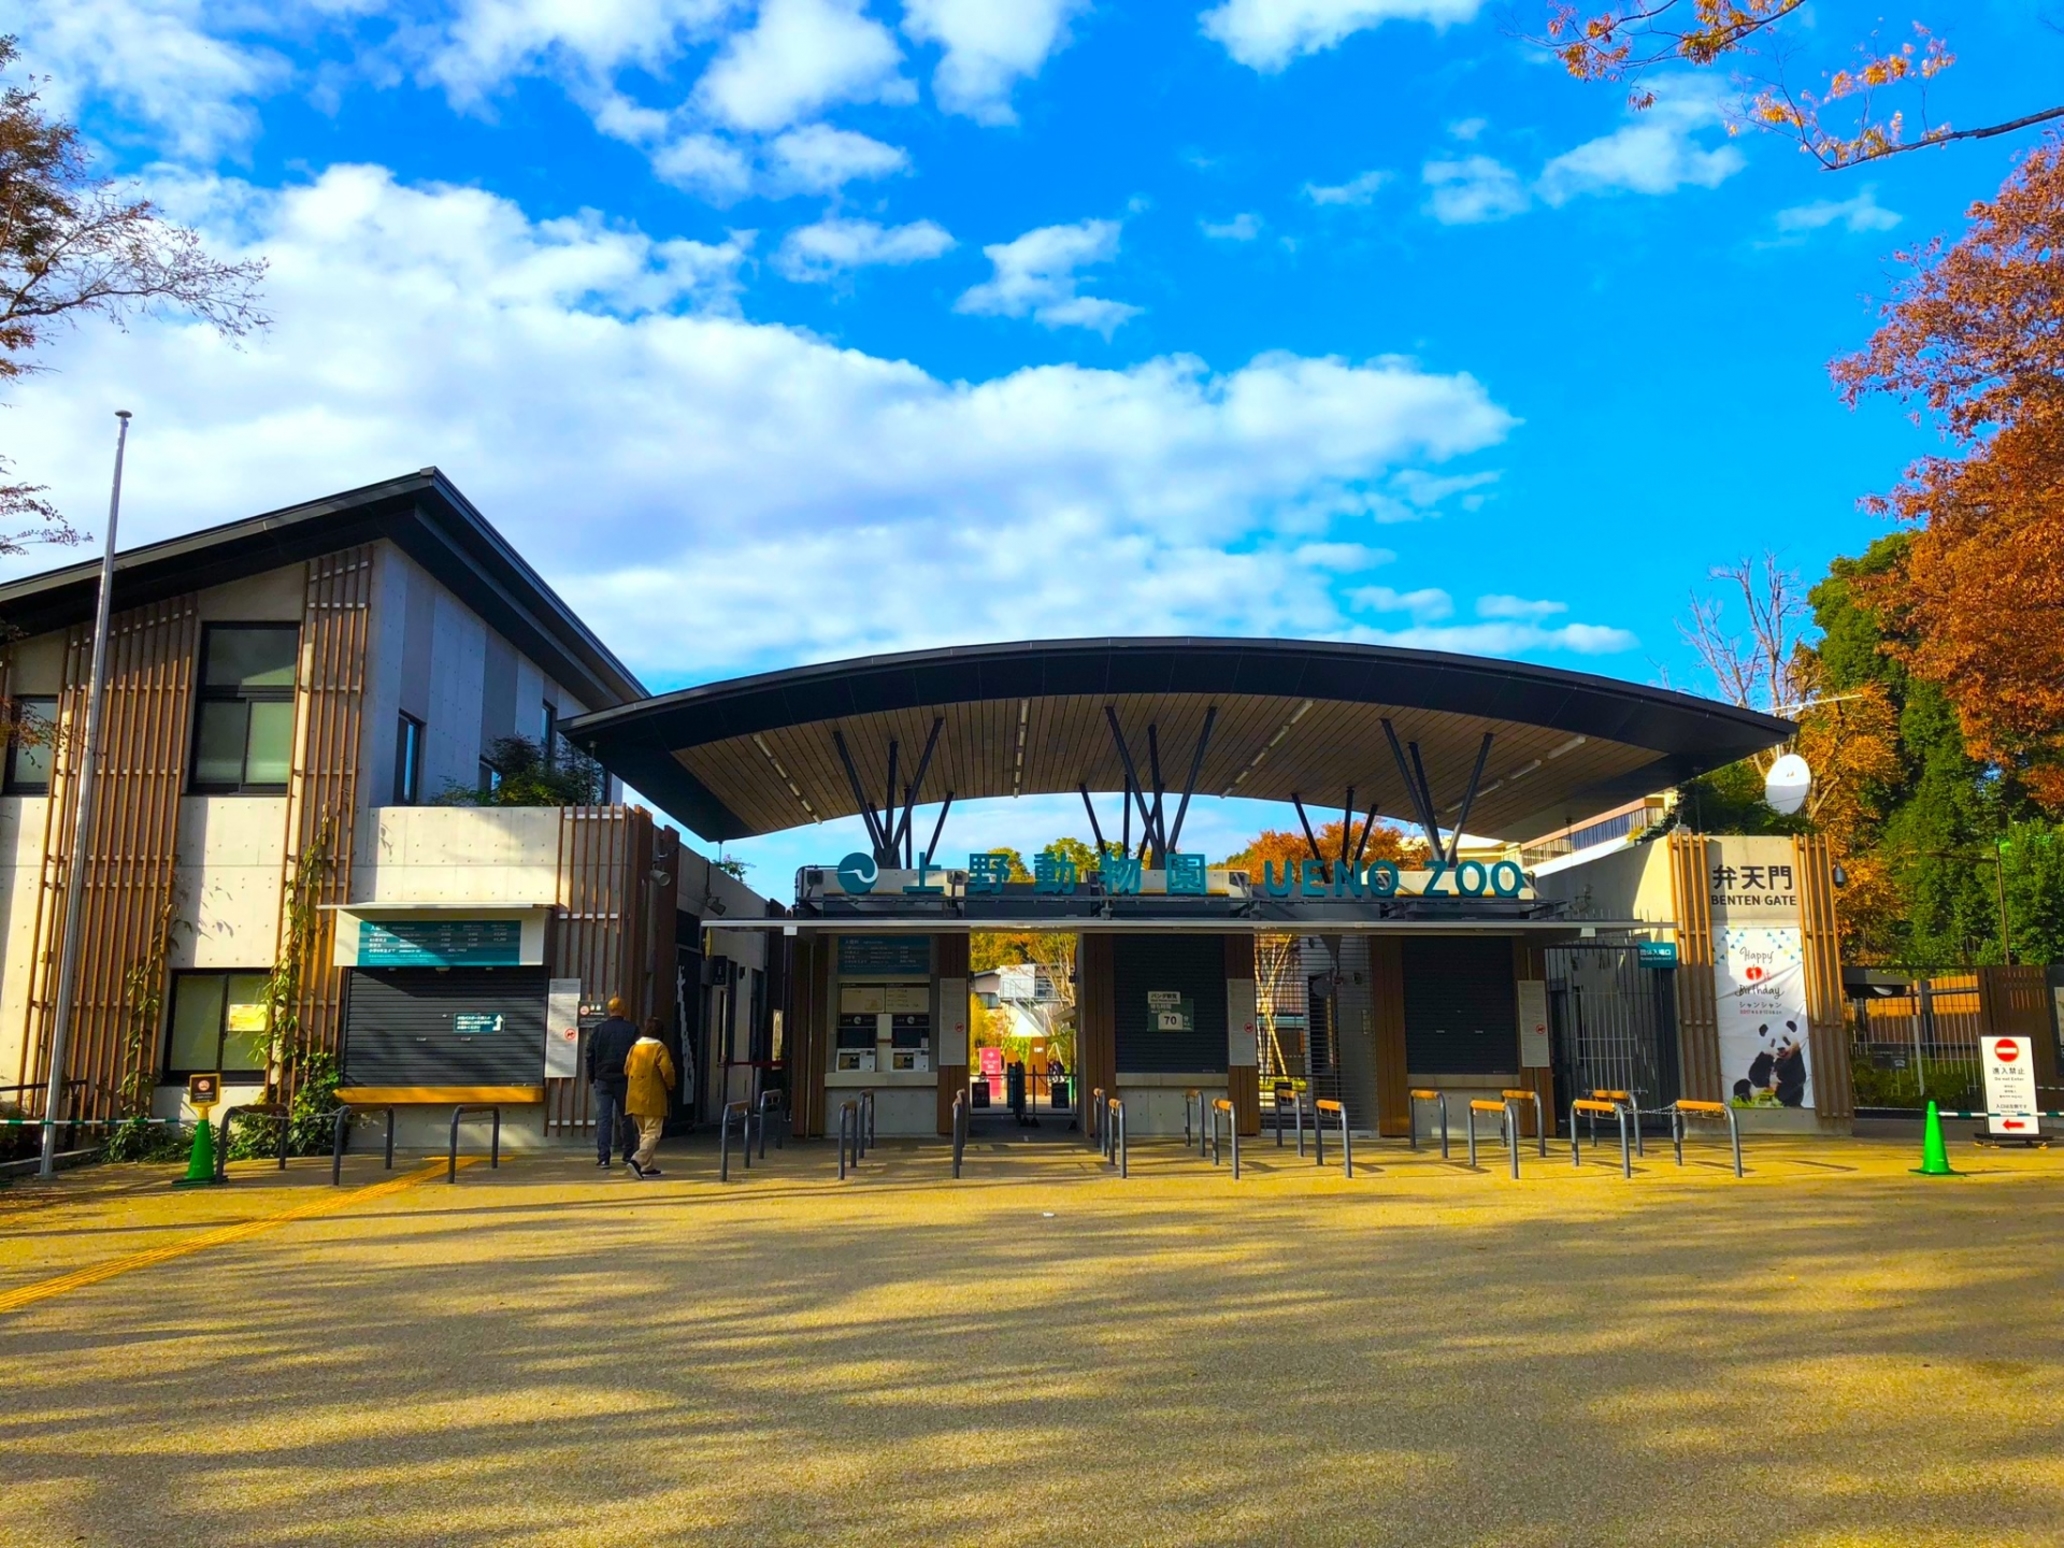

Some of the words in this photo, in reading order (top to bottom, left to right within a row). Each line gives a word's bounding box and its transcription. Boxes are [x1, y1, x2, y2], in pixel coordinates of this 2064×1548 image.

[902, 852, 1207, 895] 上野動物園
[1264, 860, 1399, 897] UENO
[1422, 860, 1524, 897] ZOO
[1712, 864, 1793, 890] 弁天門
[1711, 895, 1760, 906] BENTEN
[1764, 895, 1797, 906] GATE
[1739, 946, 1774, 964] Happy
[1734, 984, 1785, 1000] Birthday
[1164, 1016, 1177, 1025] 70
[1992, 1067, 2025, 1075] 進入禁止
